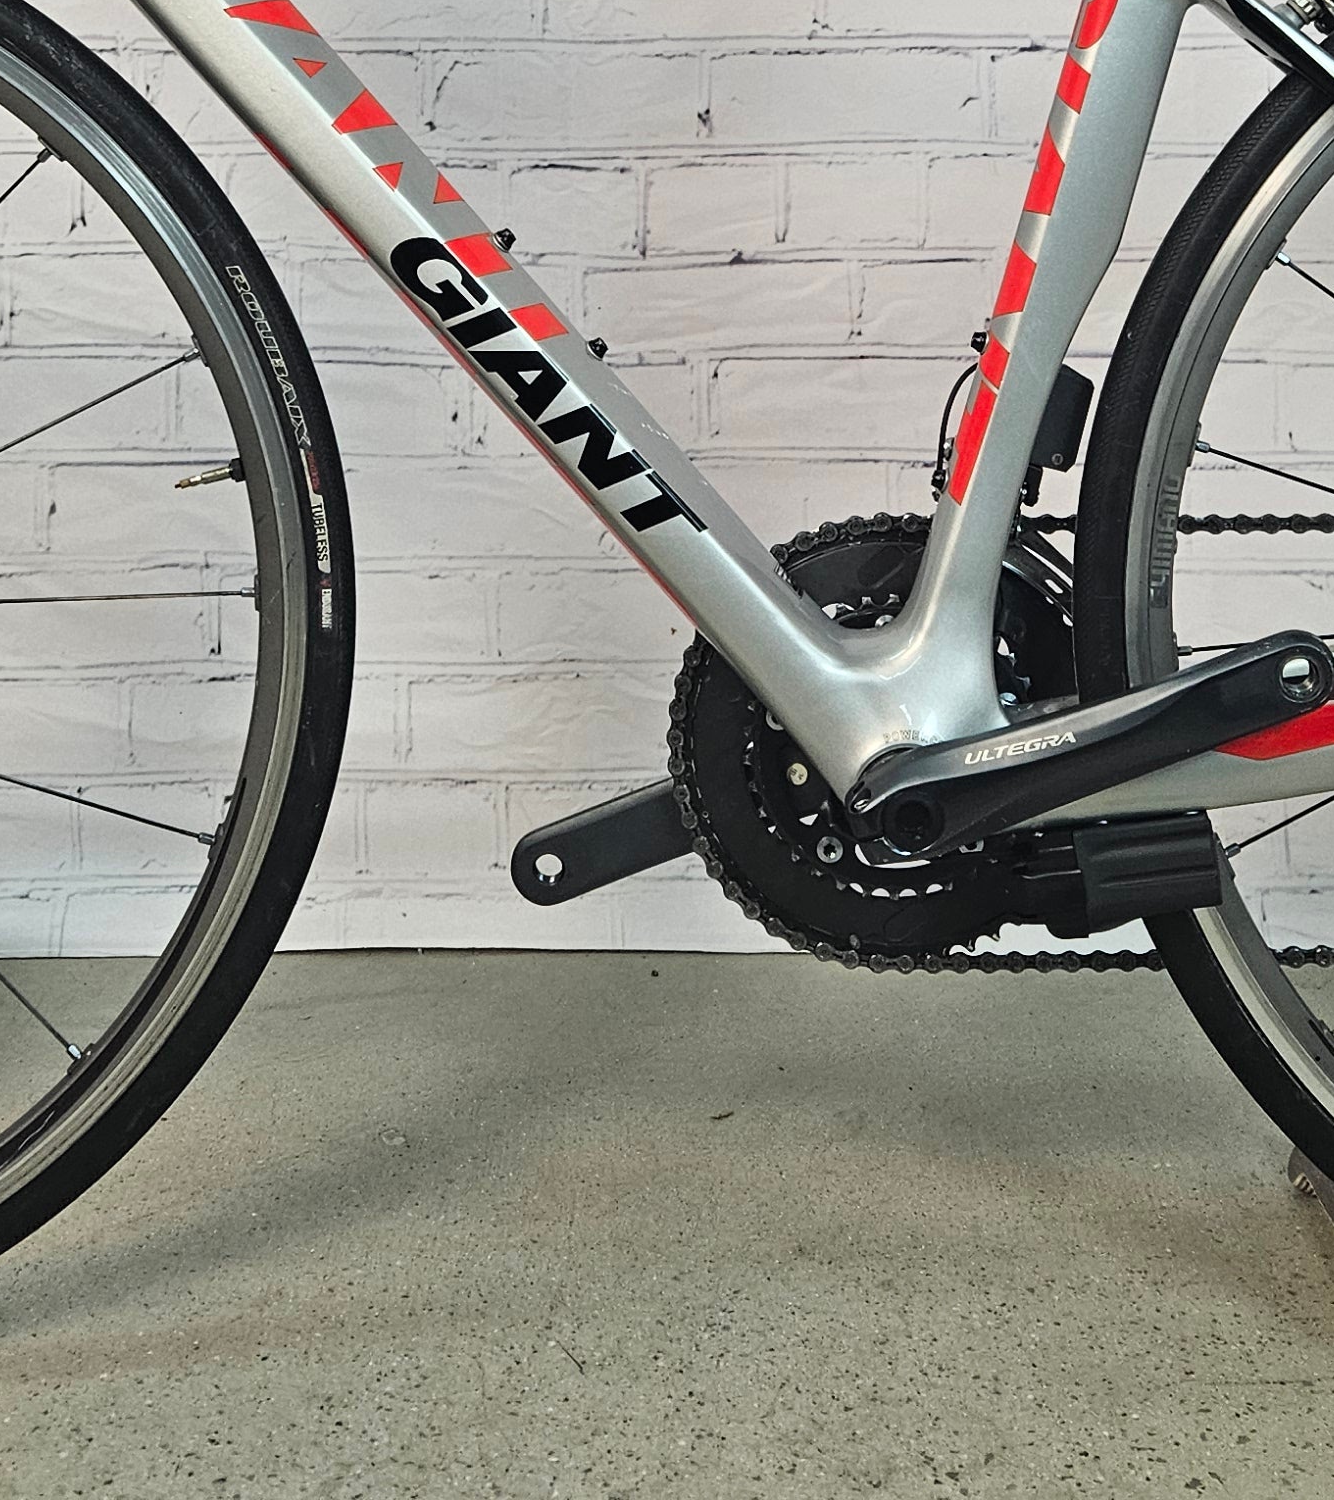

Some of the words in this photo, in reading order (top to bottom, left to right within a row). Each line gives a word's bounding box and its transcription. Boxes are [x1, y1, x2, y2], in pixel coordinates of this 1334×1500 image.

[225, 264, 312, 448] ROUBAIX
[390, 236, 709, 533] GIANT
[310, 502, 330, 564] TUBELESS
[964, 731, 1077, 766] ULTEGRA
